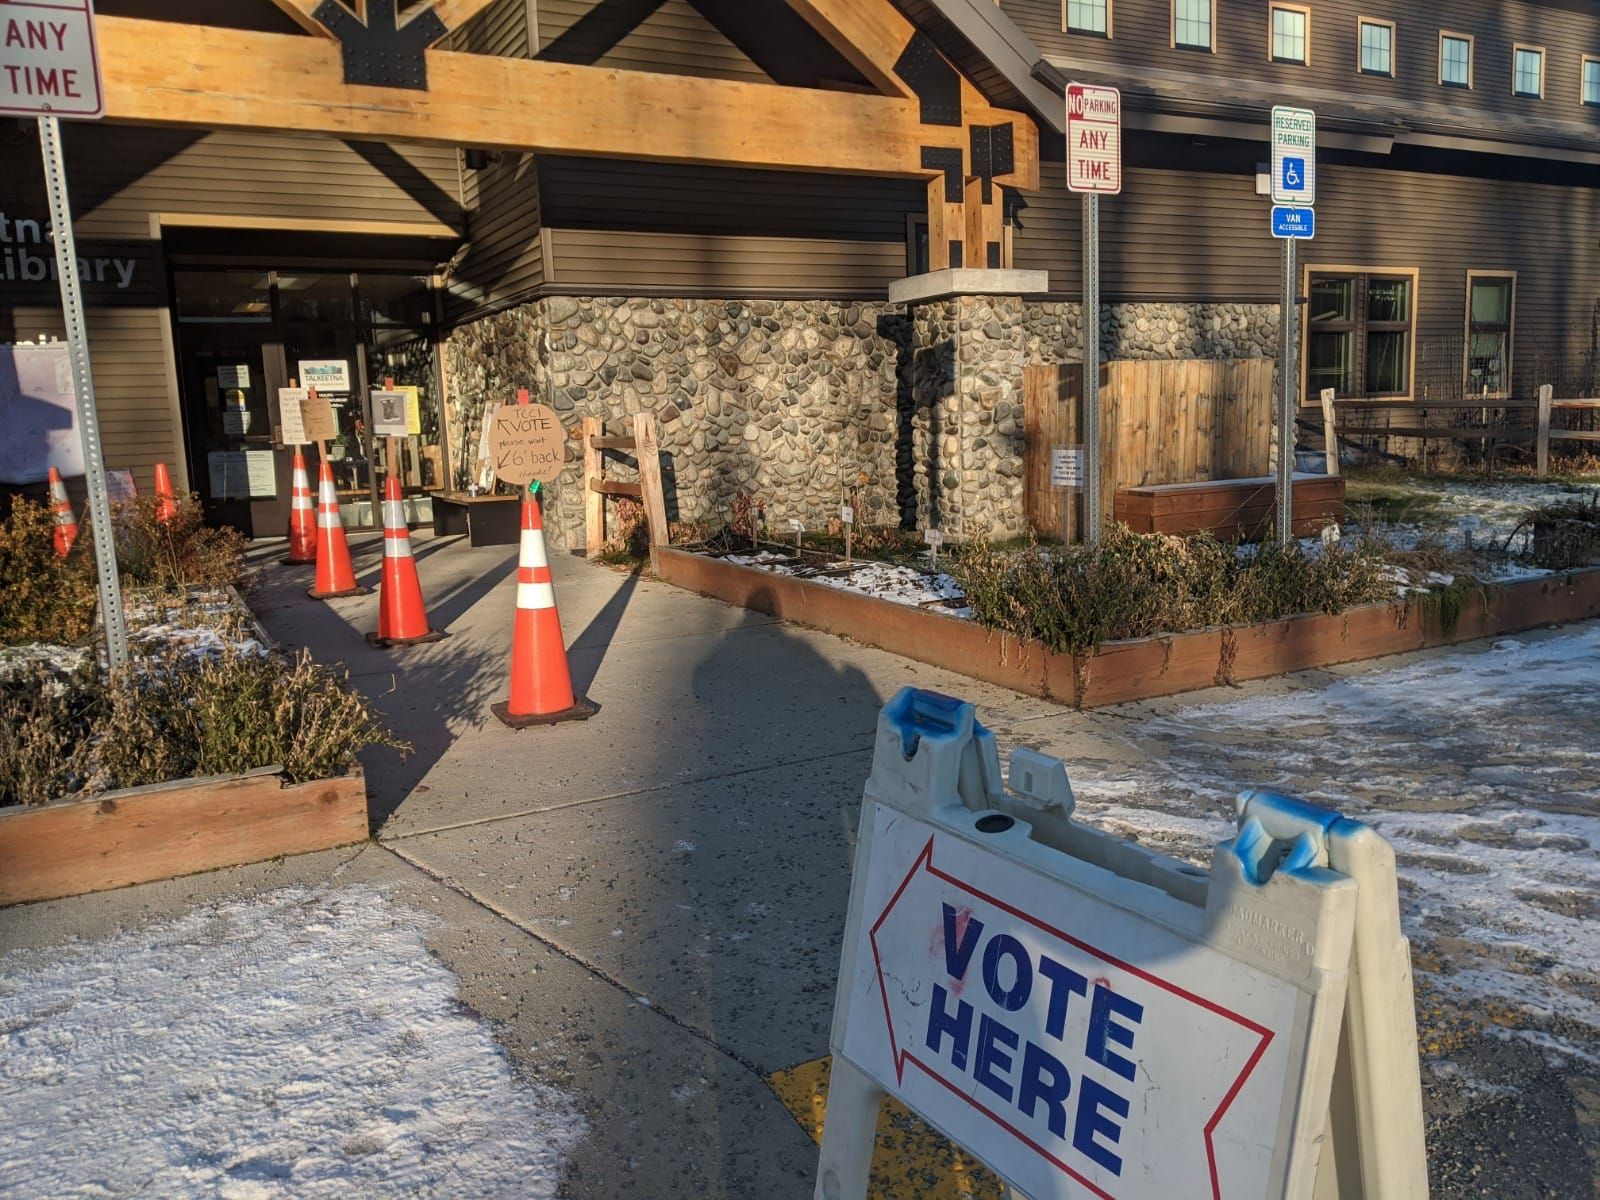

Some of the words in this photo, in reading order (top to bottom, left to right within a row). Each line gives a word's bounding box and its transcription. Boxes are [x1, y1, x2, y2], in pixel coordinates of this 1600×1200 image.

[6, 19, 68, 51] ANY
[4, 65, 81, 98] TIME
[1068, 94, 1083, 114] NO
[1084, 98, 1116, 114] PARKING
[1275, 116, 1312, 132] RESERVED
[1080, 129, 1108, 150] ANY
[1278, 133, 1310, 148] PARKING
[1078, 160, 1110, 180] TIME
[1286, 213, 1301, 223] VAN
[1279, 223, 1308, 232] ACCESSIBLE
[510, 418, 553, 432] VOTE
[528, 437, 547, 445] wait
[531, 448, 561, 464] back
[942, 902, 1144, 1083] VOTE
[926, 982, 1130, 1178] HERE
